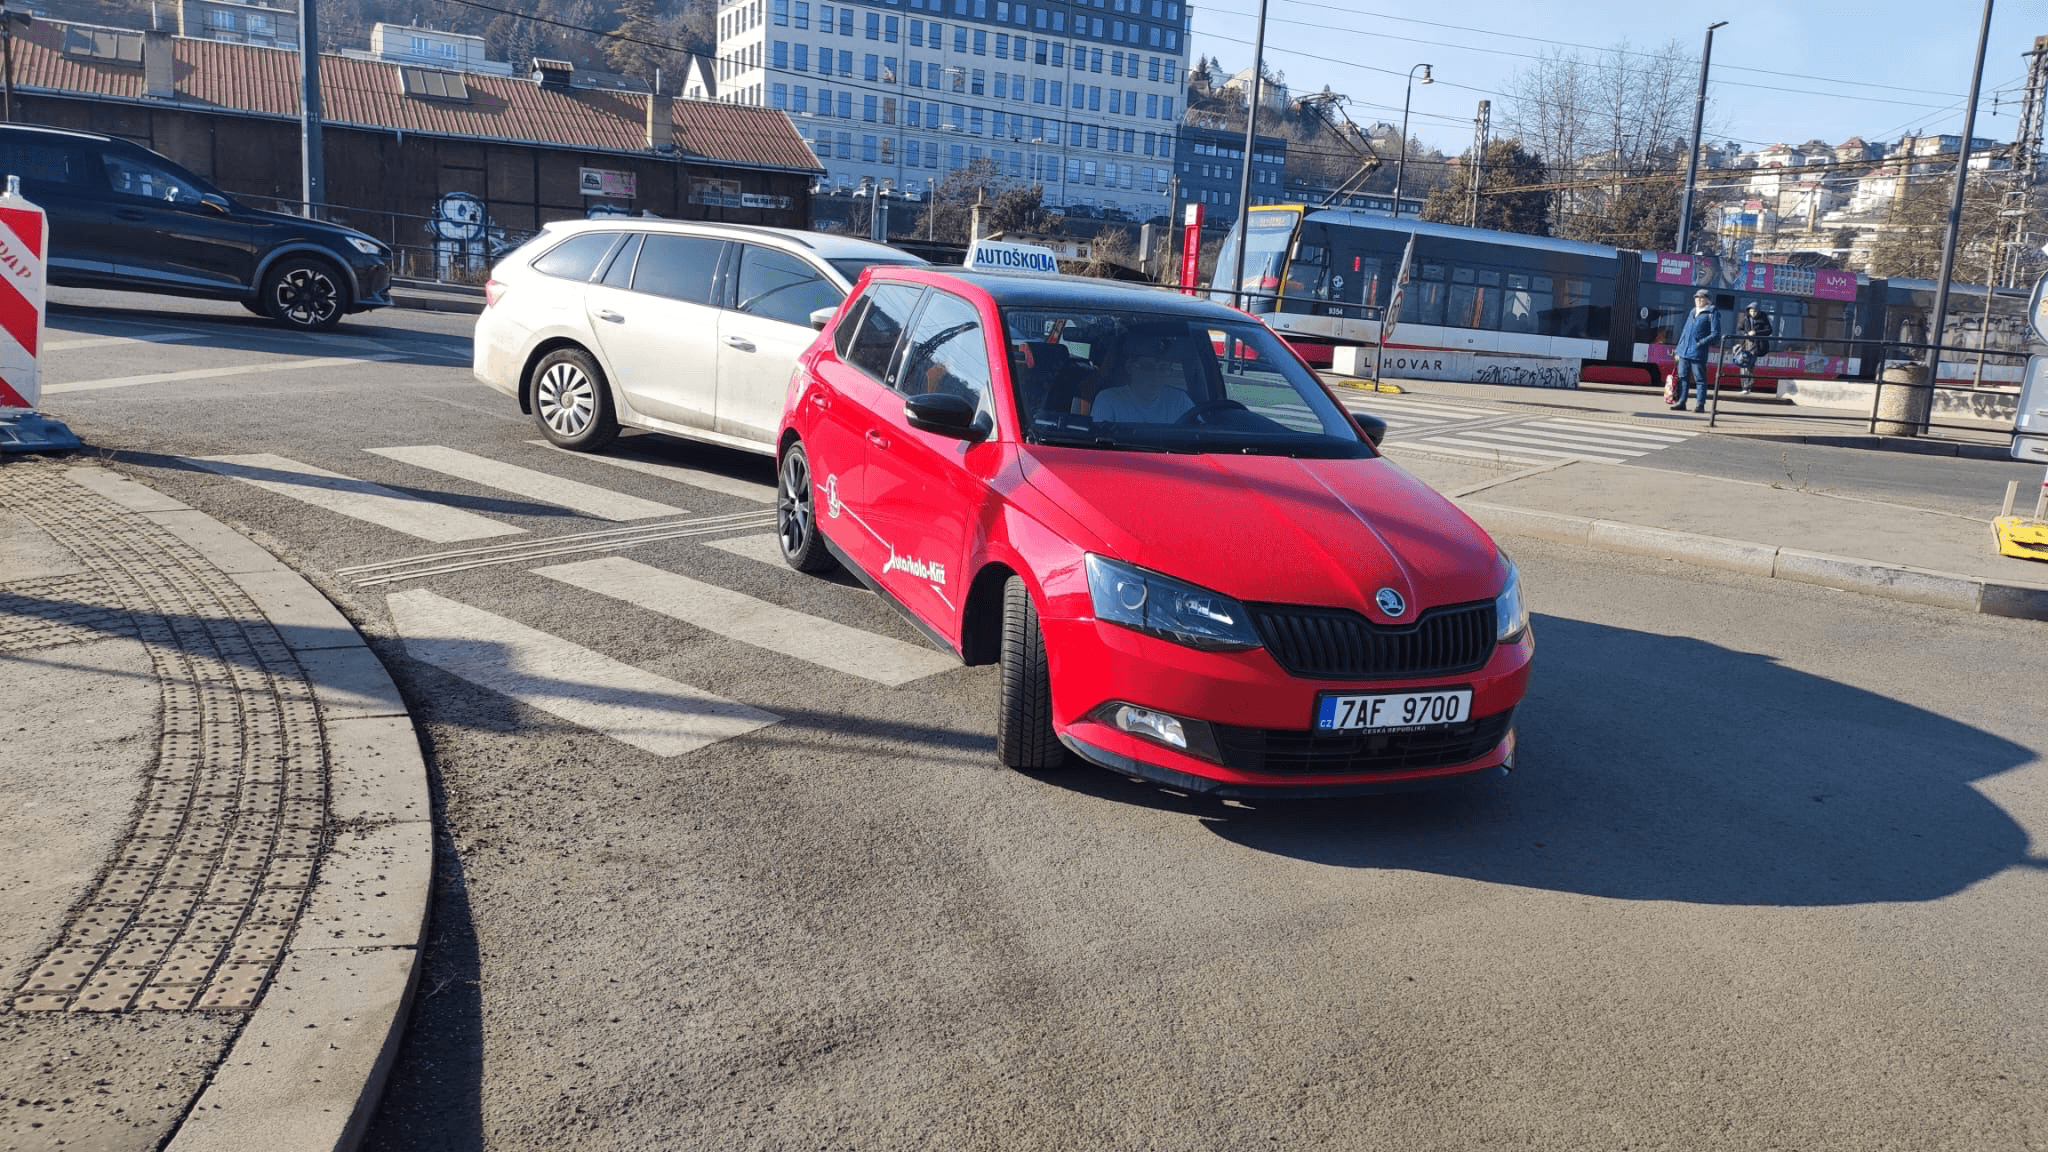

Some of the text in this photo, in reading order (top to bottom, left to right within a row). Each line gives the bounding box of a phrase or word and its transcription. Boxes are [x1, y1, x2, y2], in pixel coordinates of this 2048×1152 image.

[976, 248, 1055, 271] AUTOŠKOLA
[1364, 357, 1442, 371] LHOVAR
[1339, 695, 1460, 728] 7AF 9700
[1320, 719, 1333, 728] CZ
[1387, 724, 1426, 733] REPUBLIKA
